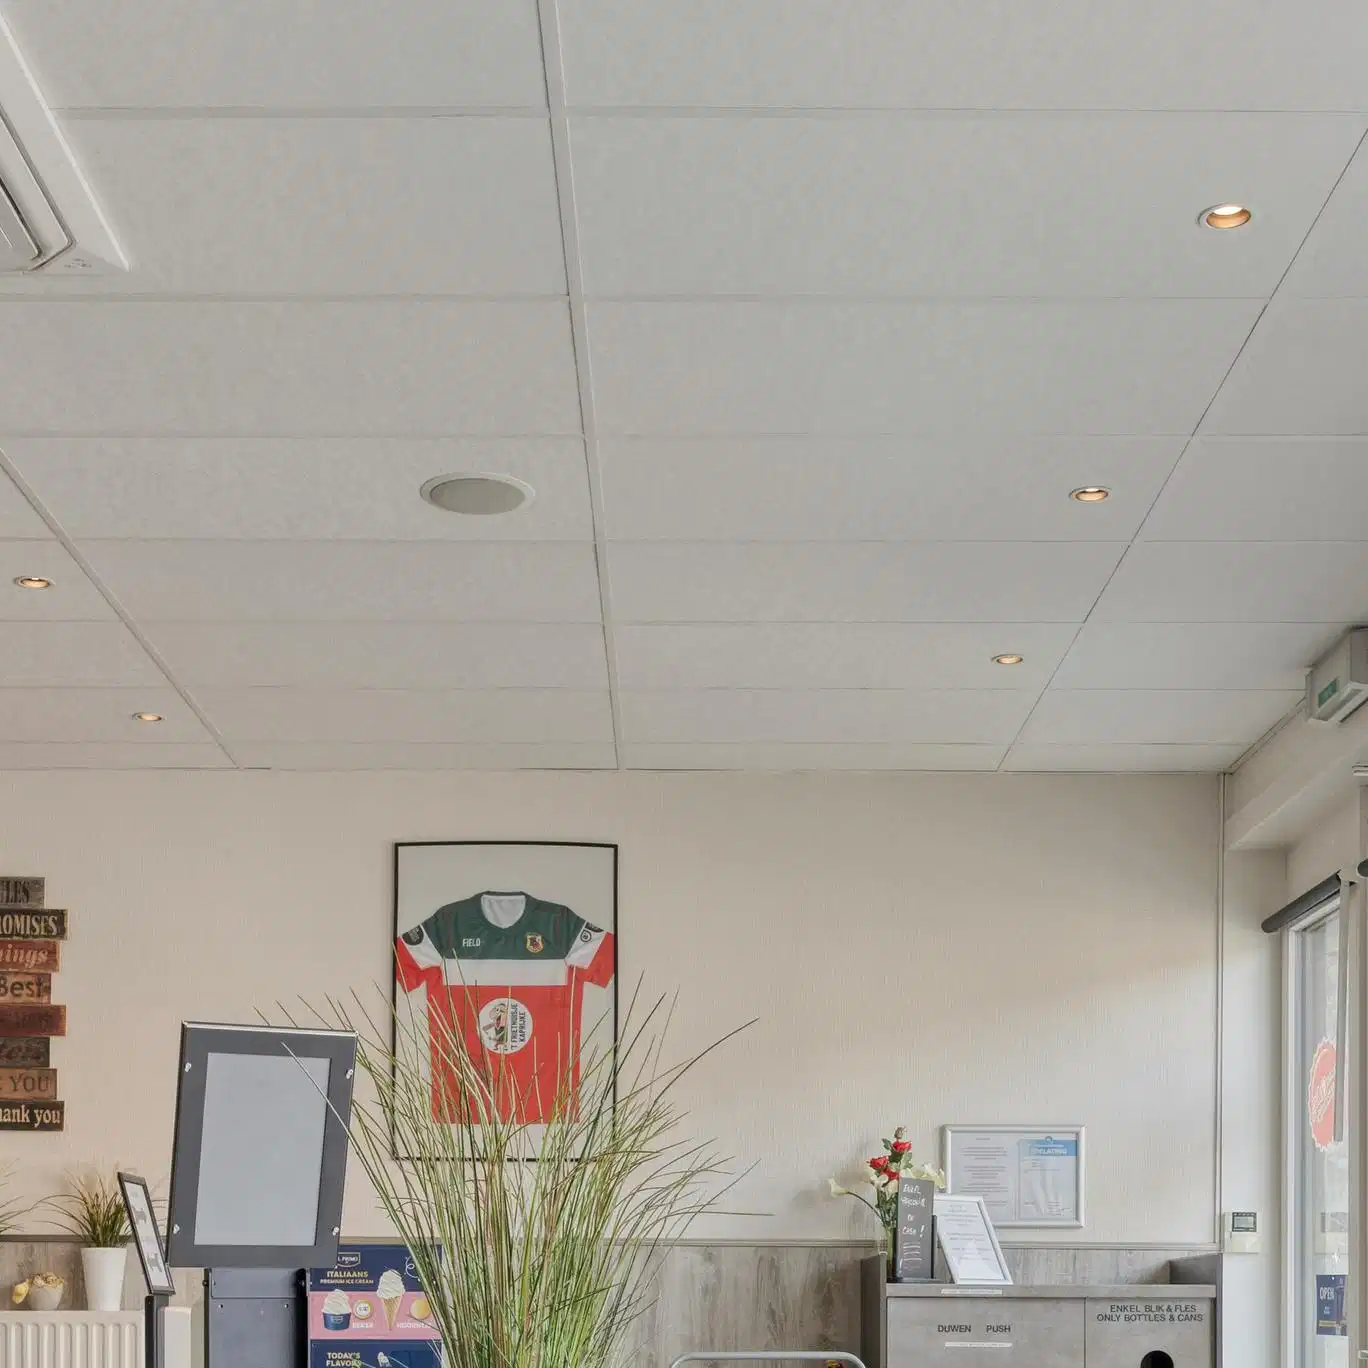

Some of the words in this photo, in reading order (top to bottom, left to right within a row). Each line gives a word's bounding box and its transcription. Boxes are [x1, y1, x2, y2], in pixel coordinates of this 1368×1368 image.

[9, 1075, 52, 1093] YOU
[34, 1109, 61, 1127] you
[327, 1270, 369, 1279] ITALIAANS
[1110, 1304, 1140, 1313] ENKEL
[1144, 1304, 1166, 1313] BLIK
[1166, 1304, 1174, 1313] &
[1174, 1304, 1197, 1313] FLES
[1096, 1313, 1121, 1322] ONLY
[1124, 1313, 1167, 1322] BOTTLES
[1169, 1313, 1176, 1322] &
[1177, 1313, 1204, 1322] CANS
[937, 1325, 972, 1333] DUWEN
[986, 1325, 1011, 1333] PUSH
[327, 1352, 361, 1360] TODAY'S
